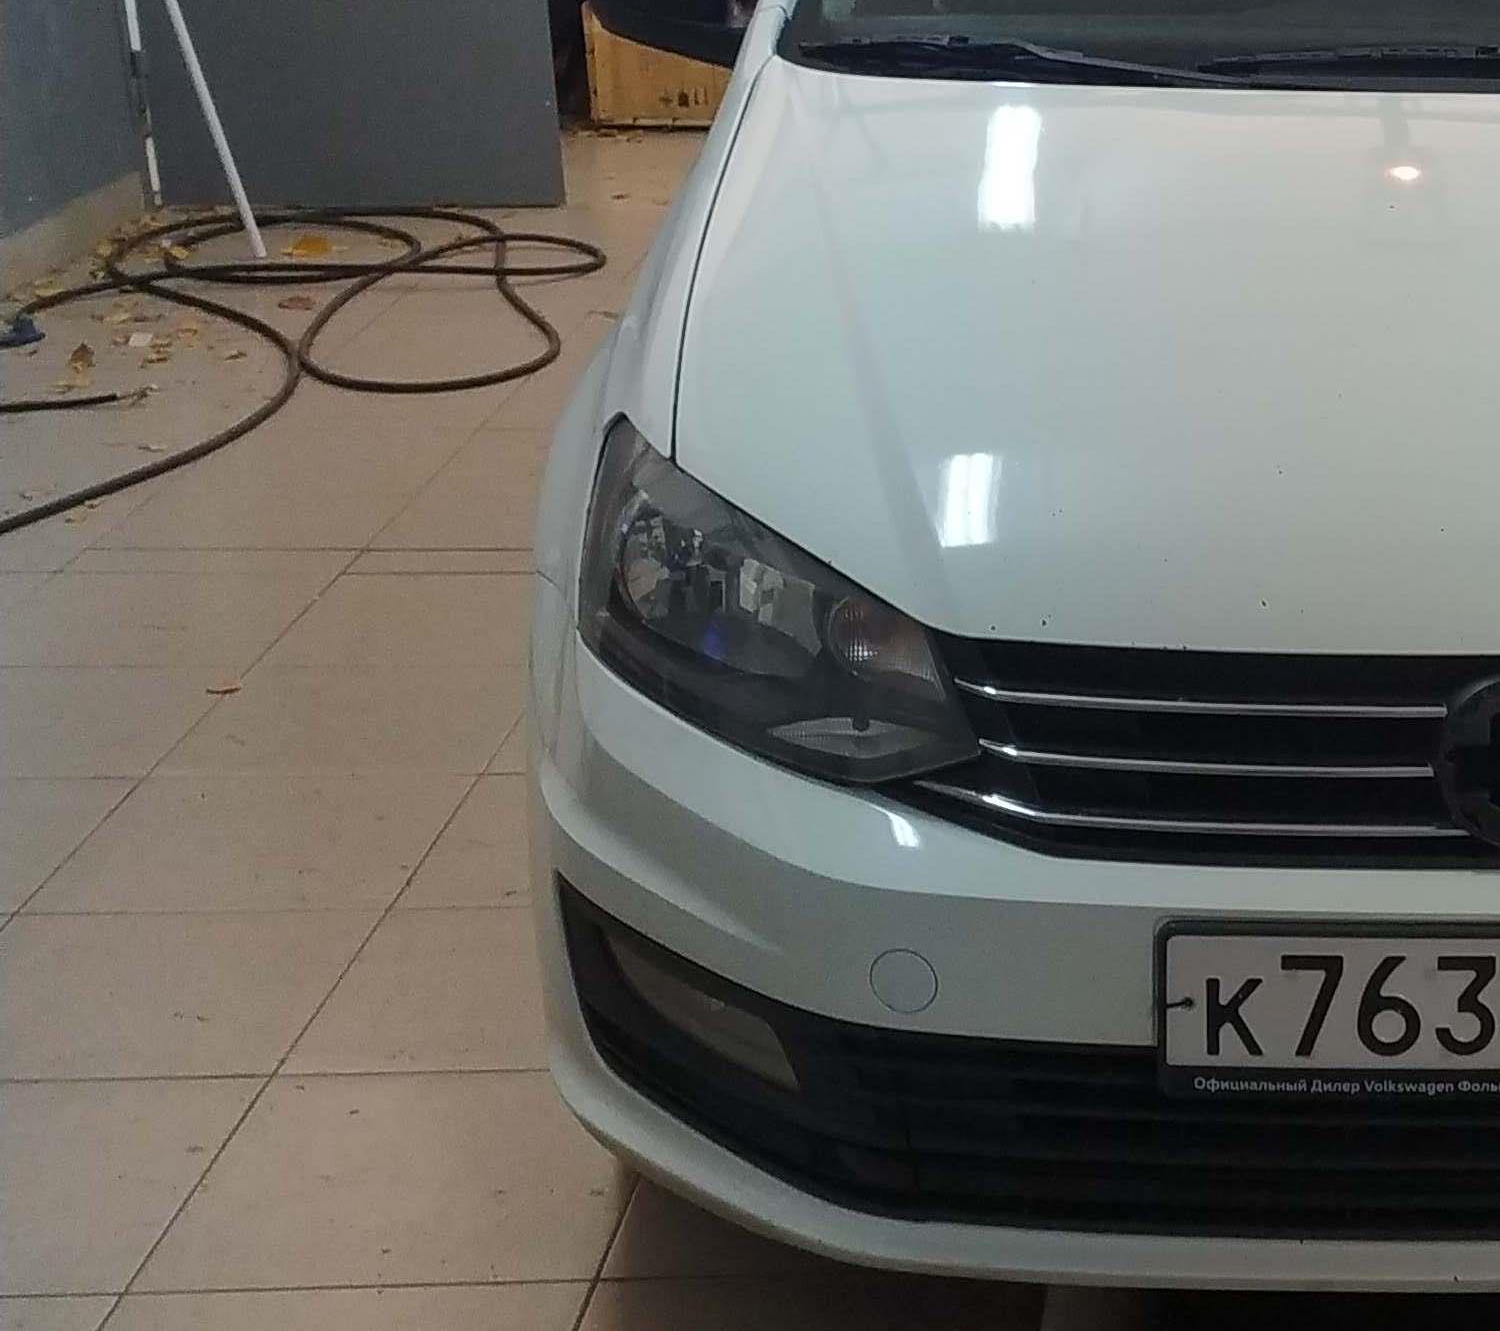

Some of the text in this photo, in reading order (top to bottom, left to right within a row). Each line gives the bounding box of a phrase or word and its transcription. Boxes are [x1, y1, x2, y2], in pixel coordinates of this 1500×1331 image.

[1194, 1076, 1307, 1093] Официальный
[1310, 1079, 1361, 1094] Дилер
[1364, 1080, 1454, 1096] Volkswagen
